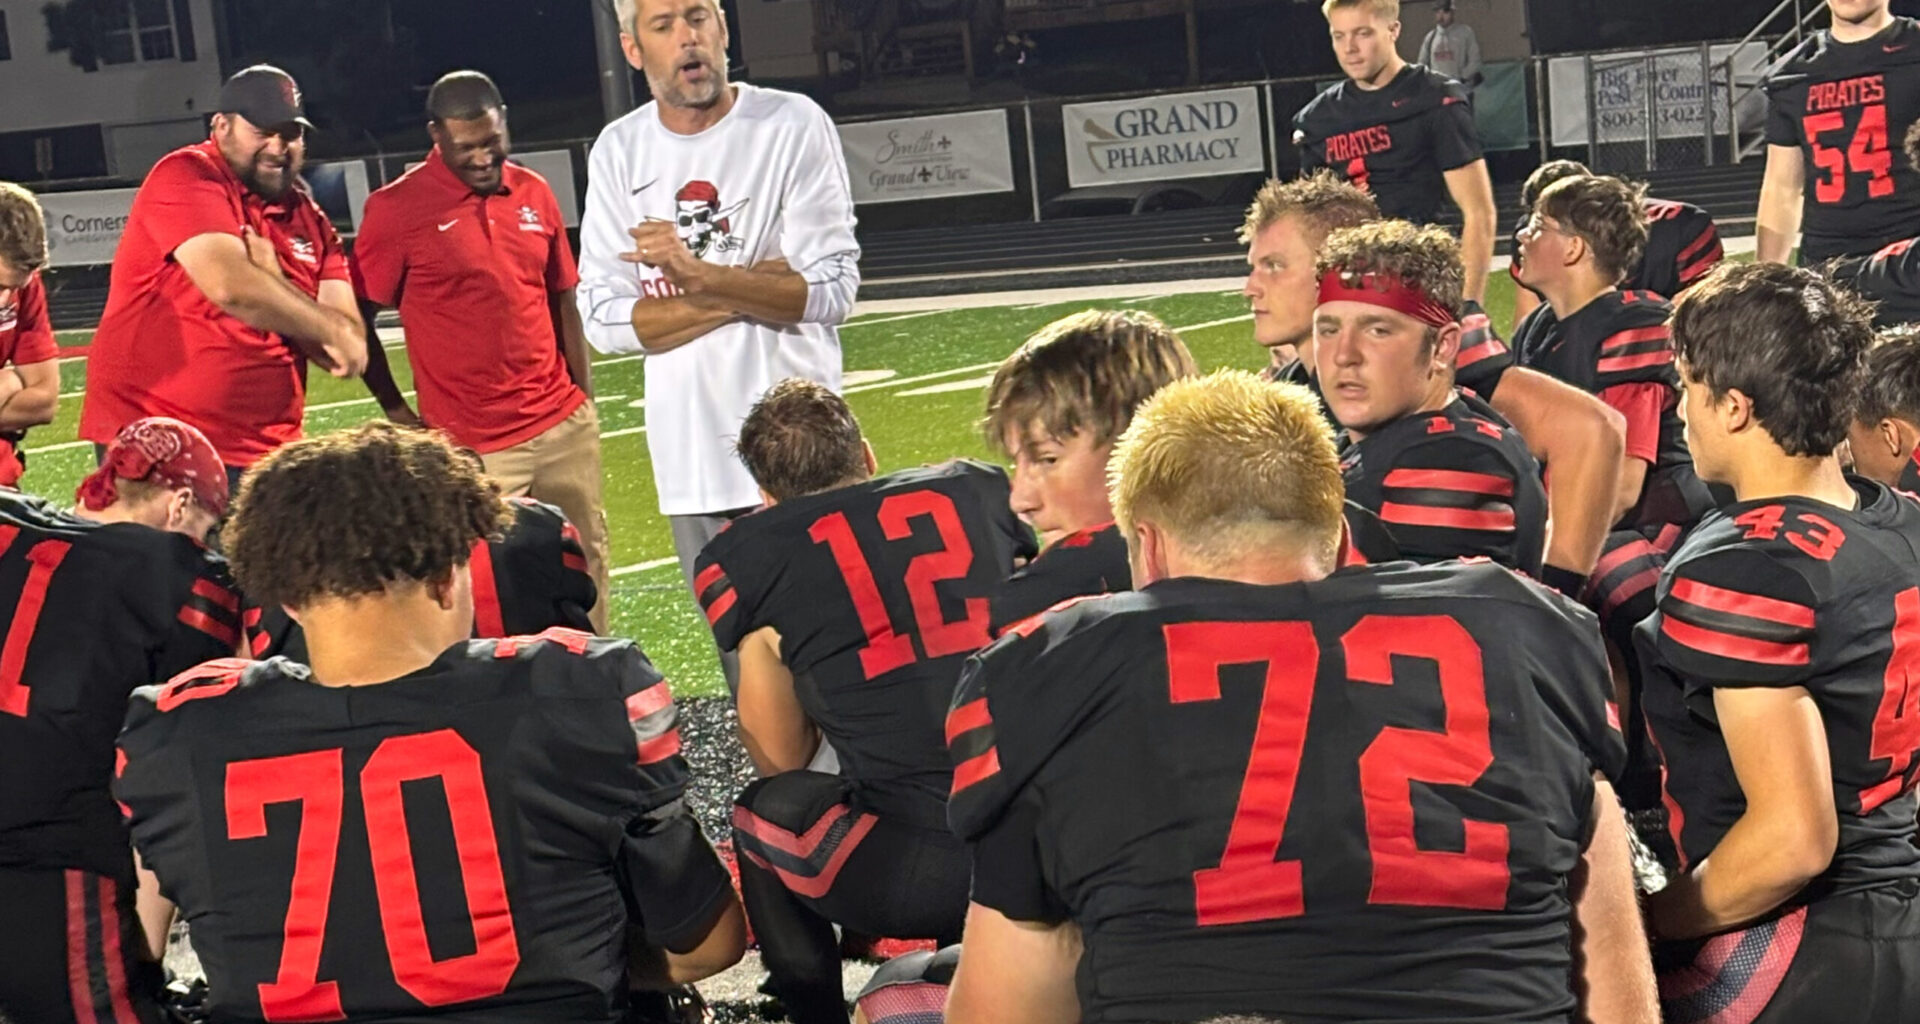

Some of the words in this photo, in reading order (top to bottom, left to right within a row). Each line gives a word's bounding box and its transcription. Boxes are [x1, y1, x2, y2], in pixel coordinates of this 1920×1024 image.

[1660, 80, 1719, 101] Contrl
[1806, 74, 1885, 112] PIRATES
[1114, 100, 1238, 140] GRAND
[1325, 123, 1392, 165] PIRATES
[868, 166, 917, 192] Grand
[1106, 137, 1239, 169] PHARMACY
[1803, 104, 1895, 203] 54
[1734, 504, 1846, 562] 43
[808, 489, 991, 680] 12
[0, 524, 73, 718] 1
[1858, 586, 1920, 815] 4
[1163, 614, 1511, 926] 72
[224, 728, 520, 1023] 70
